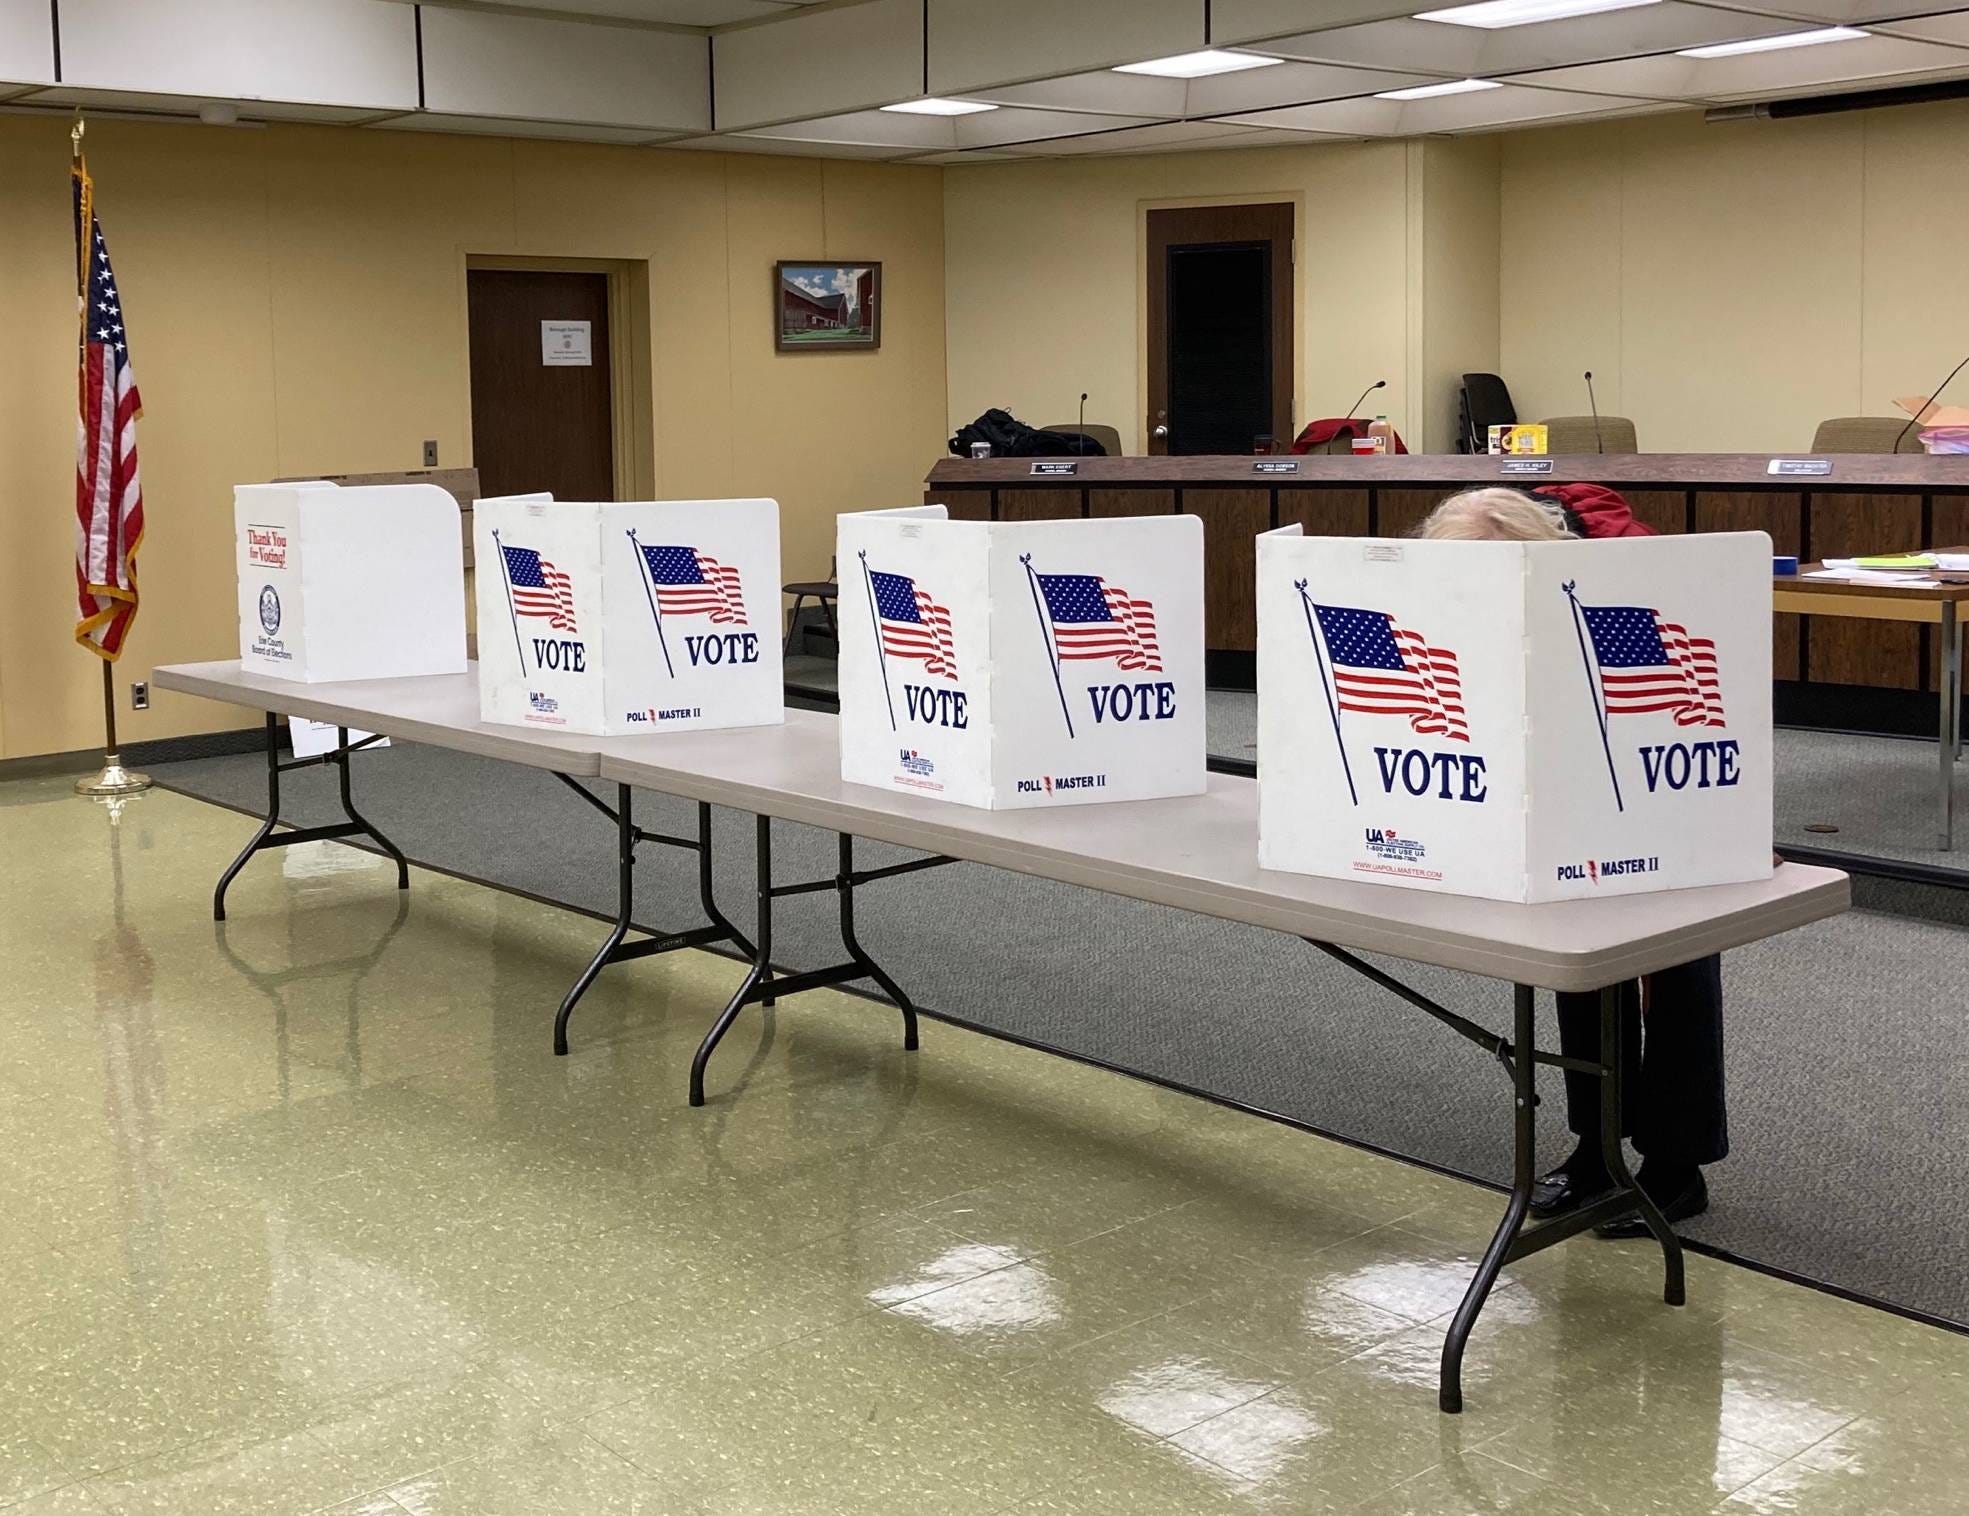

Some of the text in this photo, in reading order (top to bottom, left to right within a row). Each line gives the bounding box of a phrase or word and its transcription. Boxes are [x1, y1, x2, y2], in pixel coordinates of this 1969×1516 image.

[248, 529, 287, 547] Thank You
[250, 547, 286, 568] for Voting!
[252, 645, 265, 655] Board
[267, 637, 284, 650] County
[685, 633, 759, 666] VOTE
[533, 639, 585, 672] VOTE
[904, 685, 968, 729] VOTE
[1088, 682, 1175, 723] VOTE
[627, 708, 701, 722] POLL MASTER II
[1374, 747, 1487, 802] VOTE
[1639, 740, 1740, 792] VOTE
[1018, 775, 1106, 793] POLL MASTER II
[1366, 828, 1384, 843] UA
[1558, 857, 1659, 881] POLL MASTER II
